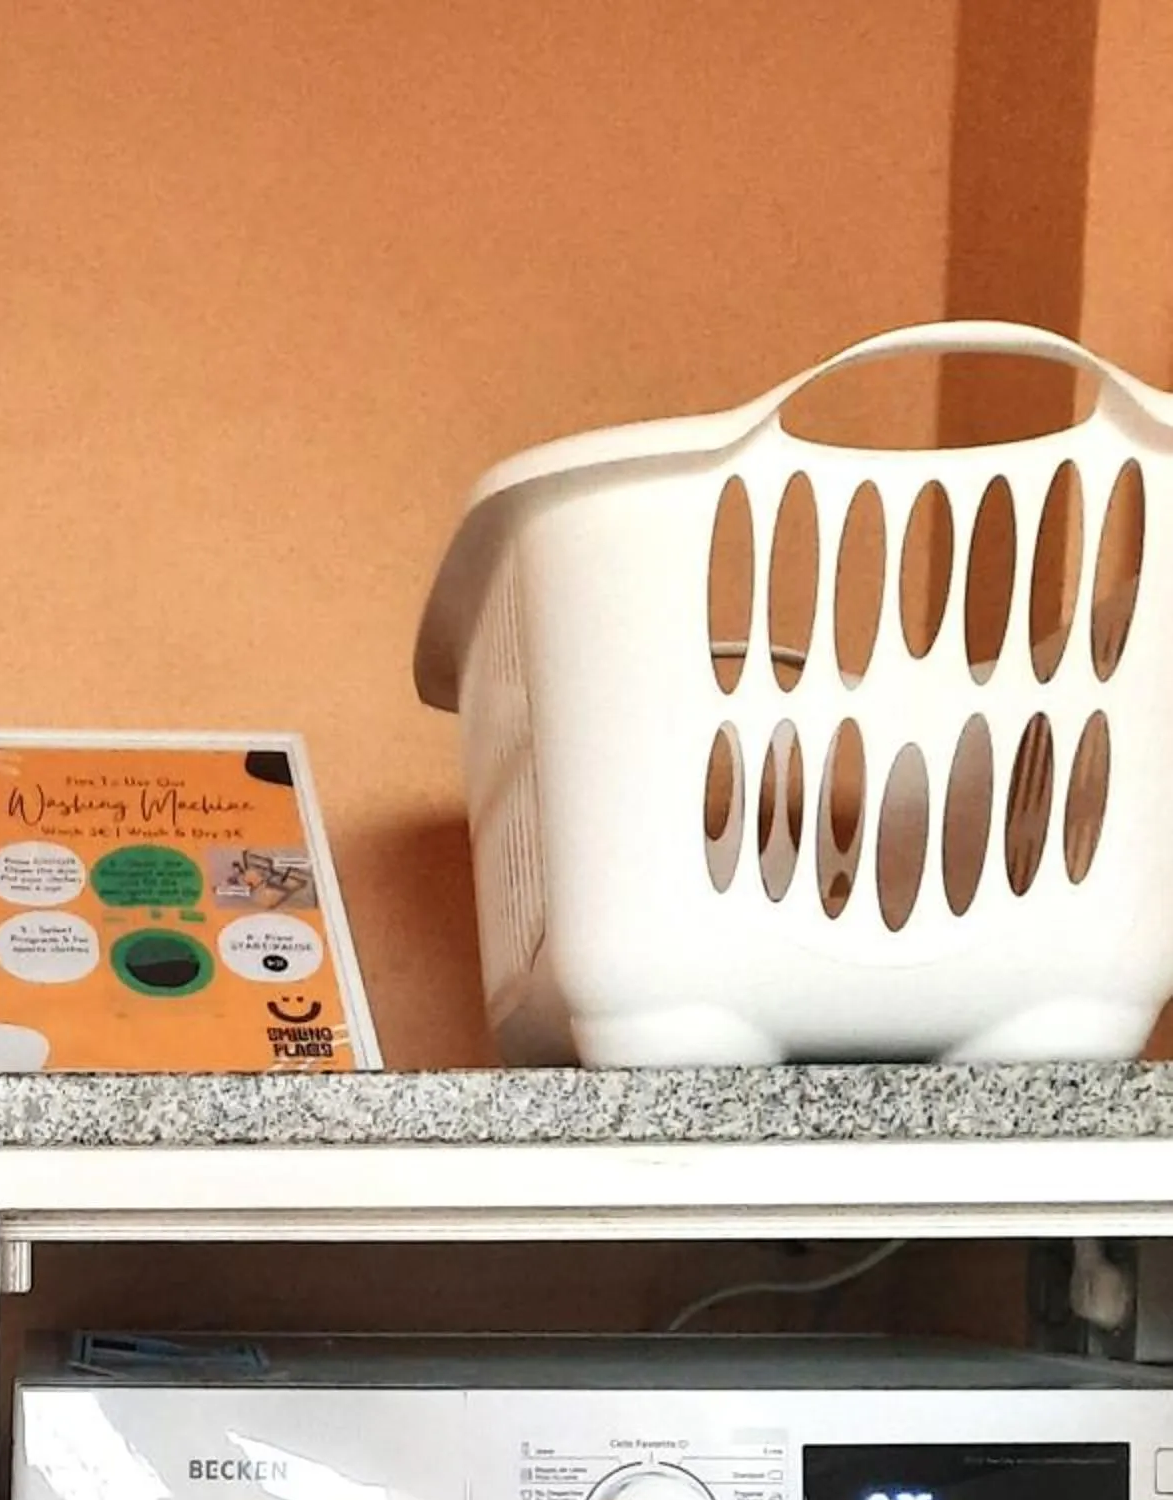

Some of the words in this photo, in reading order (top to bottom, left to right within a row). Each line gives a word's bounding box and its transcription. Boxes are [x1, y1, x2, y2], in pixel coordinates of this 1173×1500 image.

[8, 784, 127, 827] Washing
[140, 787, 255, 826] Machine
[188, 1459, 288, 1481] BECKEN
